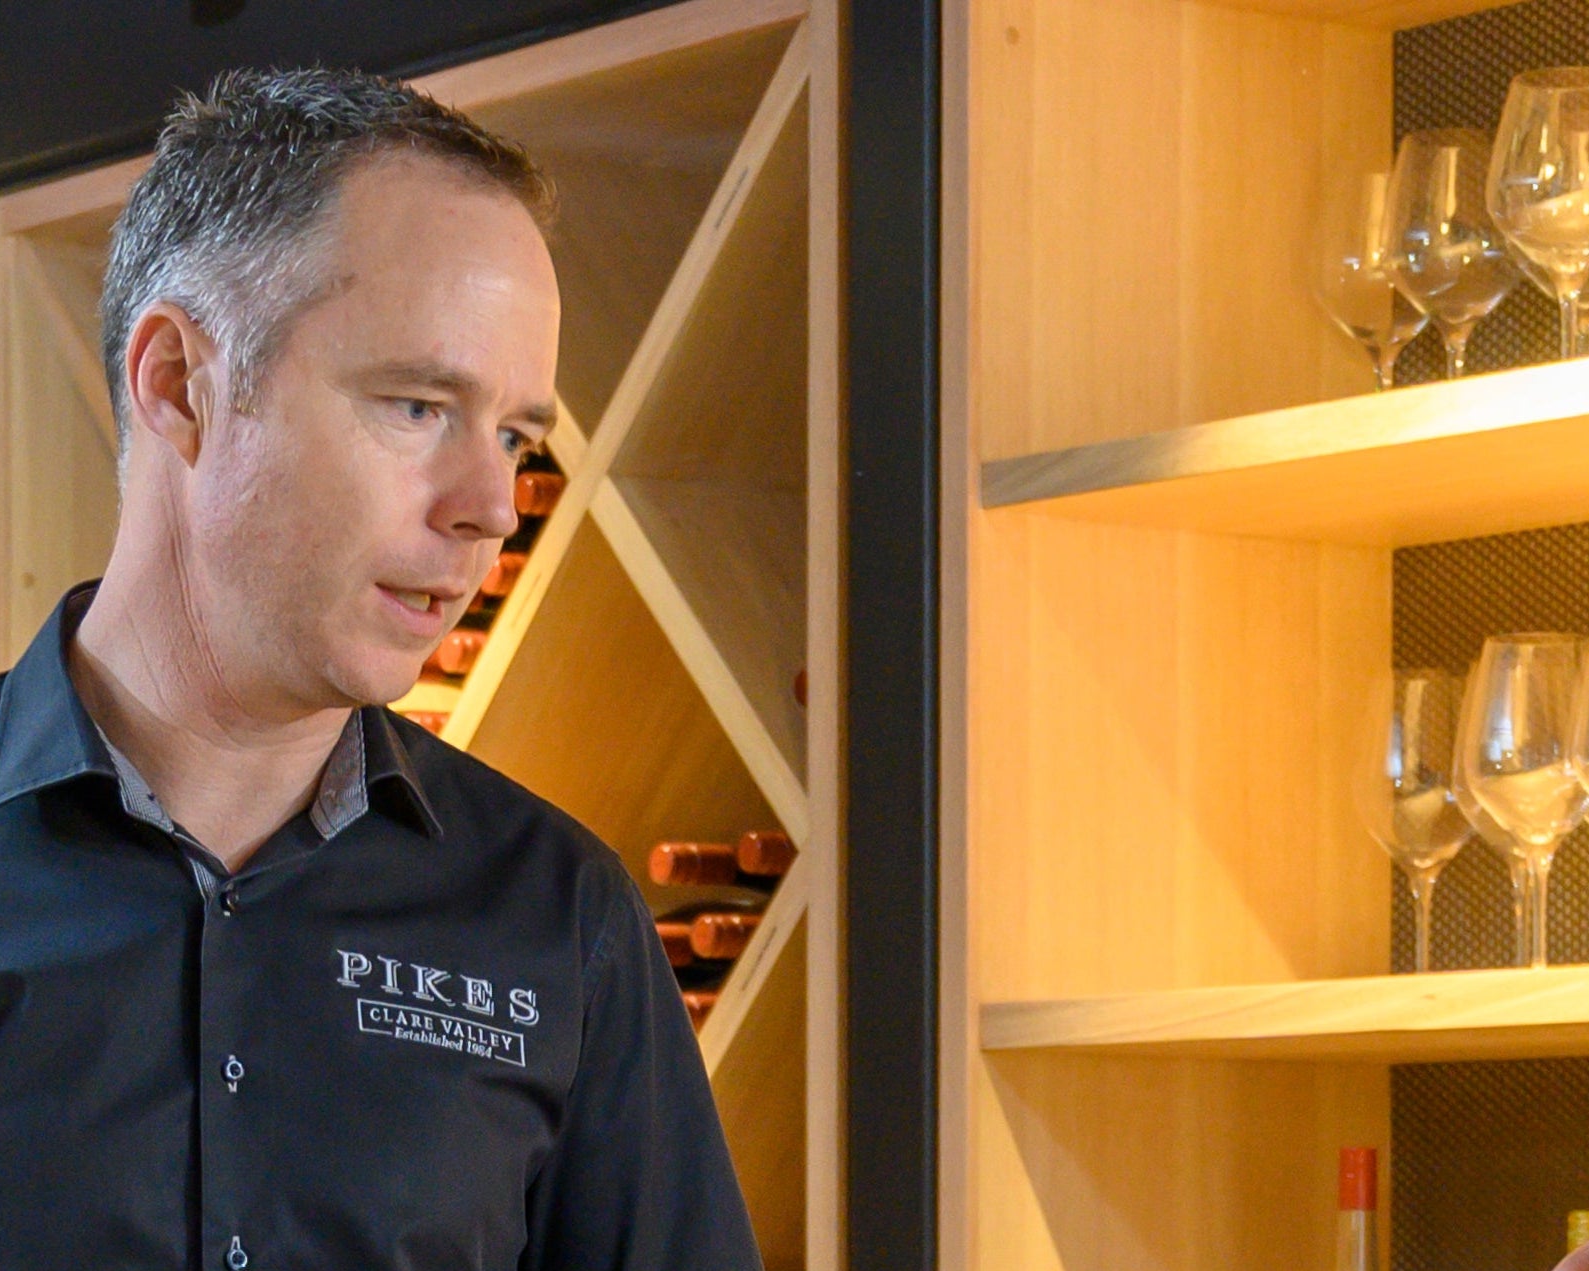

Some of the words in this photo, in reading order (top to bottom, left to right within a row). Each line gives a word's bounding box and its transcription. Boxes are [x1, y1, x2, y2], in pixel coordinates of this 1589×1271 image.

[337, 949, 539, 1026] PIKES
[369, 1008, 434, 1031] CLARE
[441, 1019, 513, 1050] VALLEY
[395, 1027, 463, 1051] Established
[467, 1042, 493, 1059] 1984
